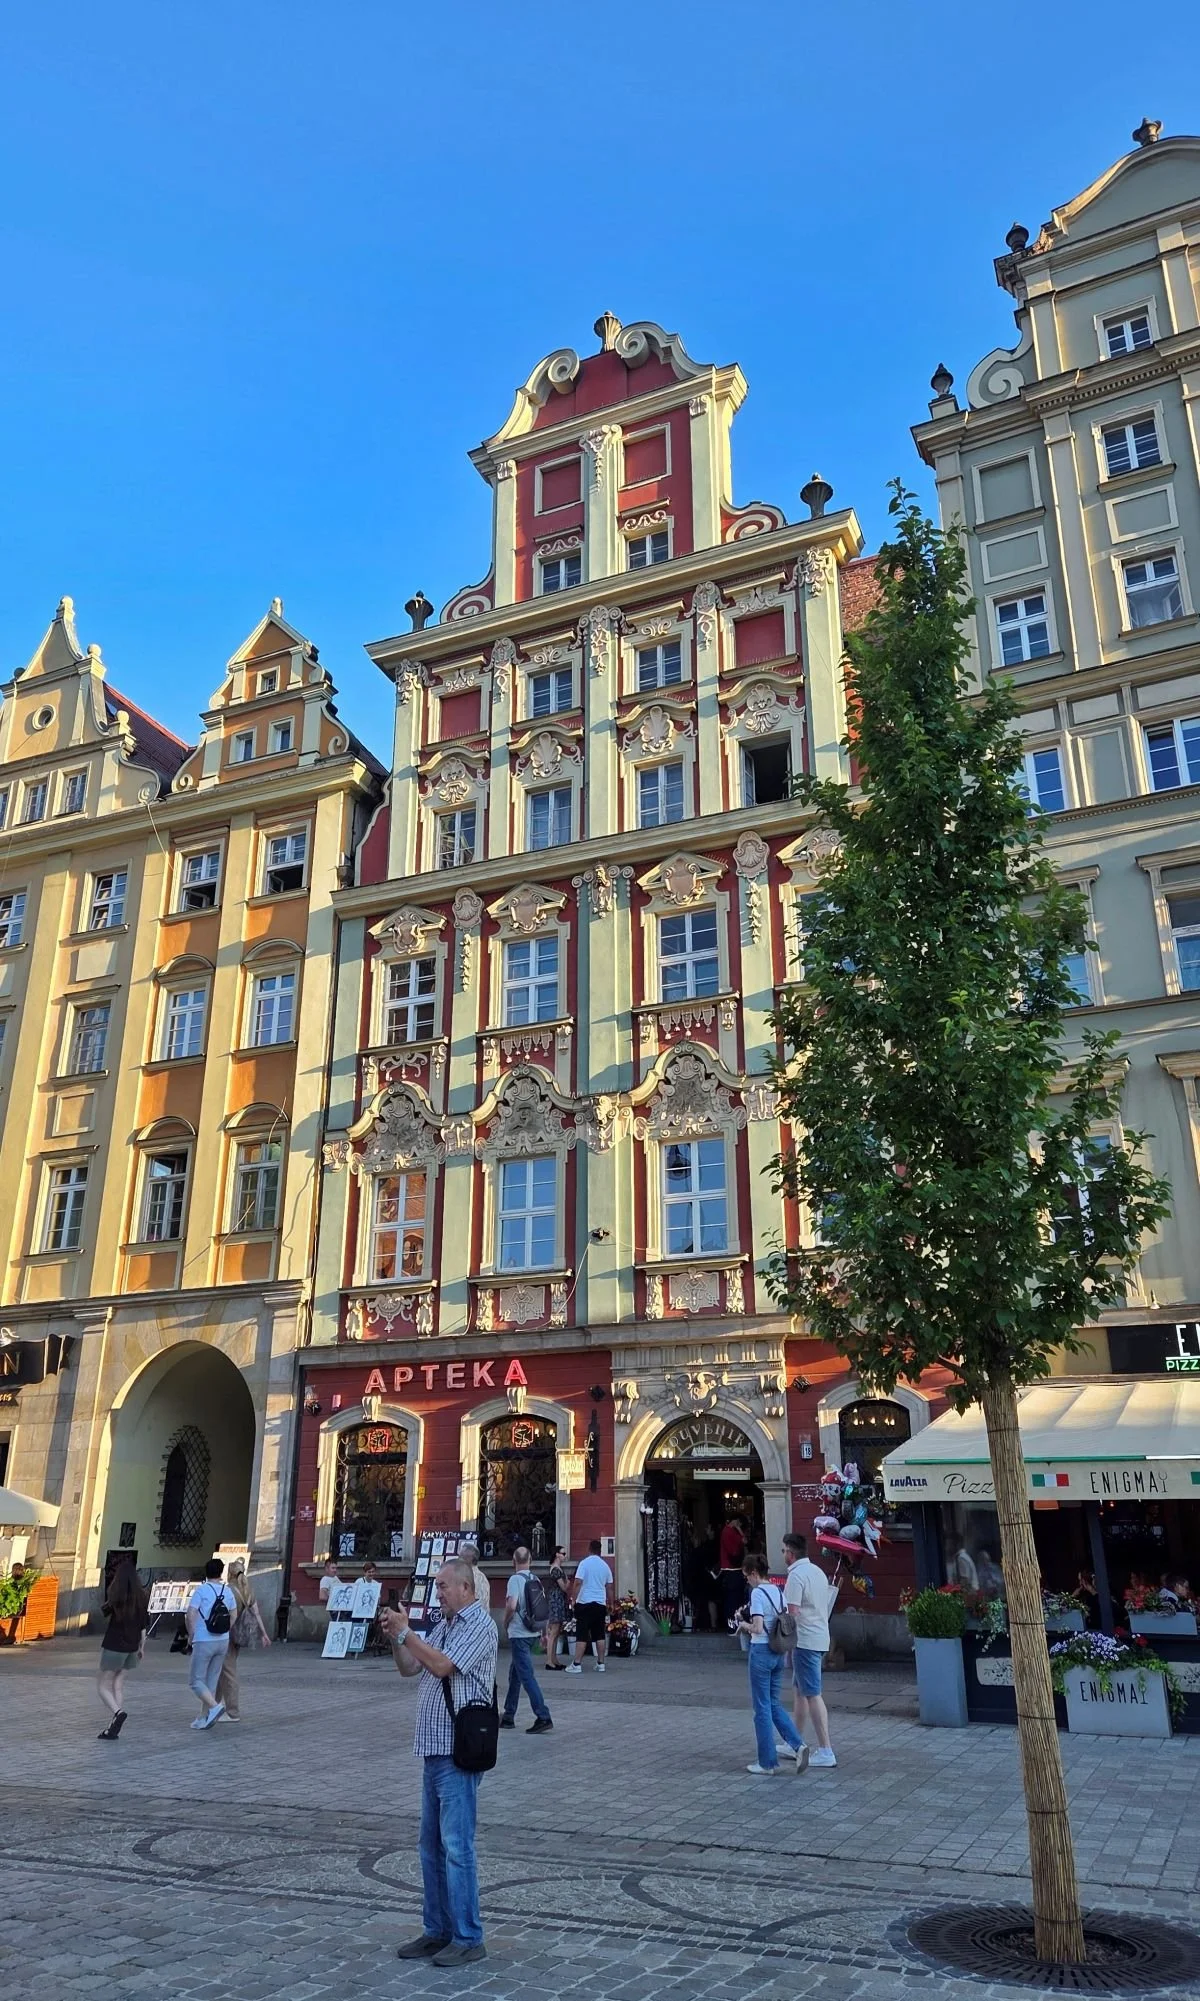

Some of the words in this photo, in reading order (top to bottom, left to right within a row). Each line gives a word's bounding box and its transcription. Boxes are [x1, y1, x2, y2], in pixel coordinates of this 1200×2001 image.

[364, 1359, 528, 1394] APTEKA
[890, 1475, 928, 1487] LAVAZZA
[943, 1472, 996, 1494] Pizz
[1090, 1471, 1159, 1494] ENIGMA
